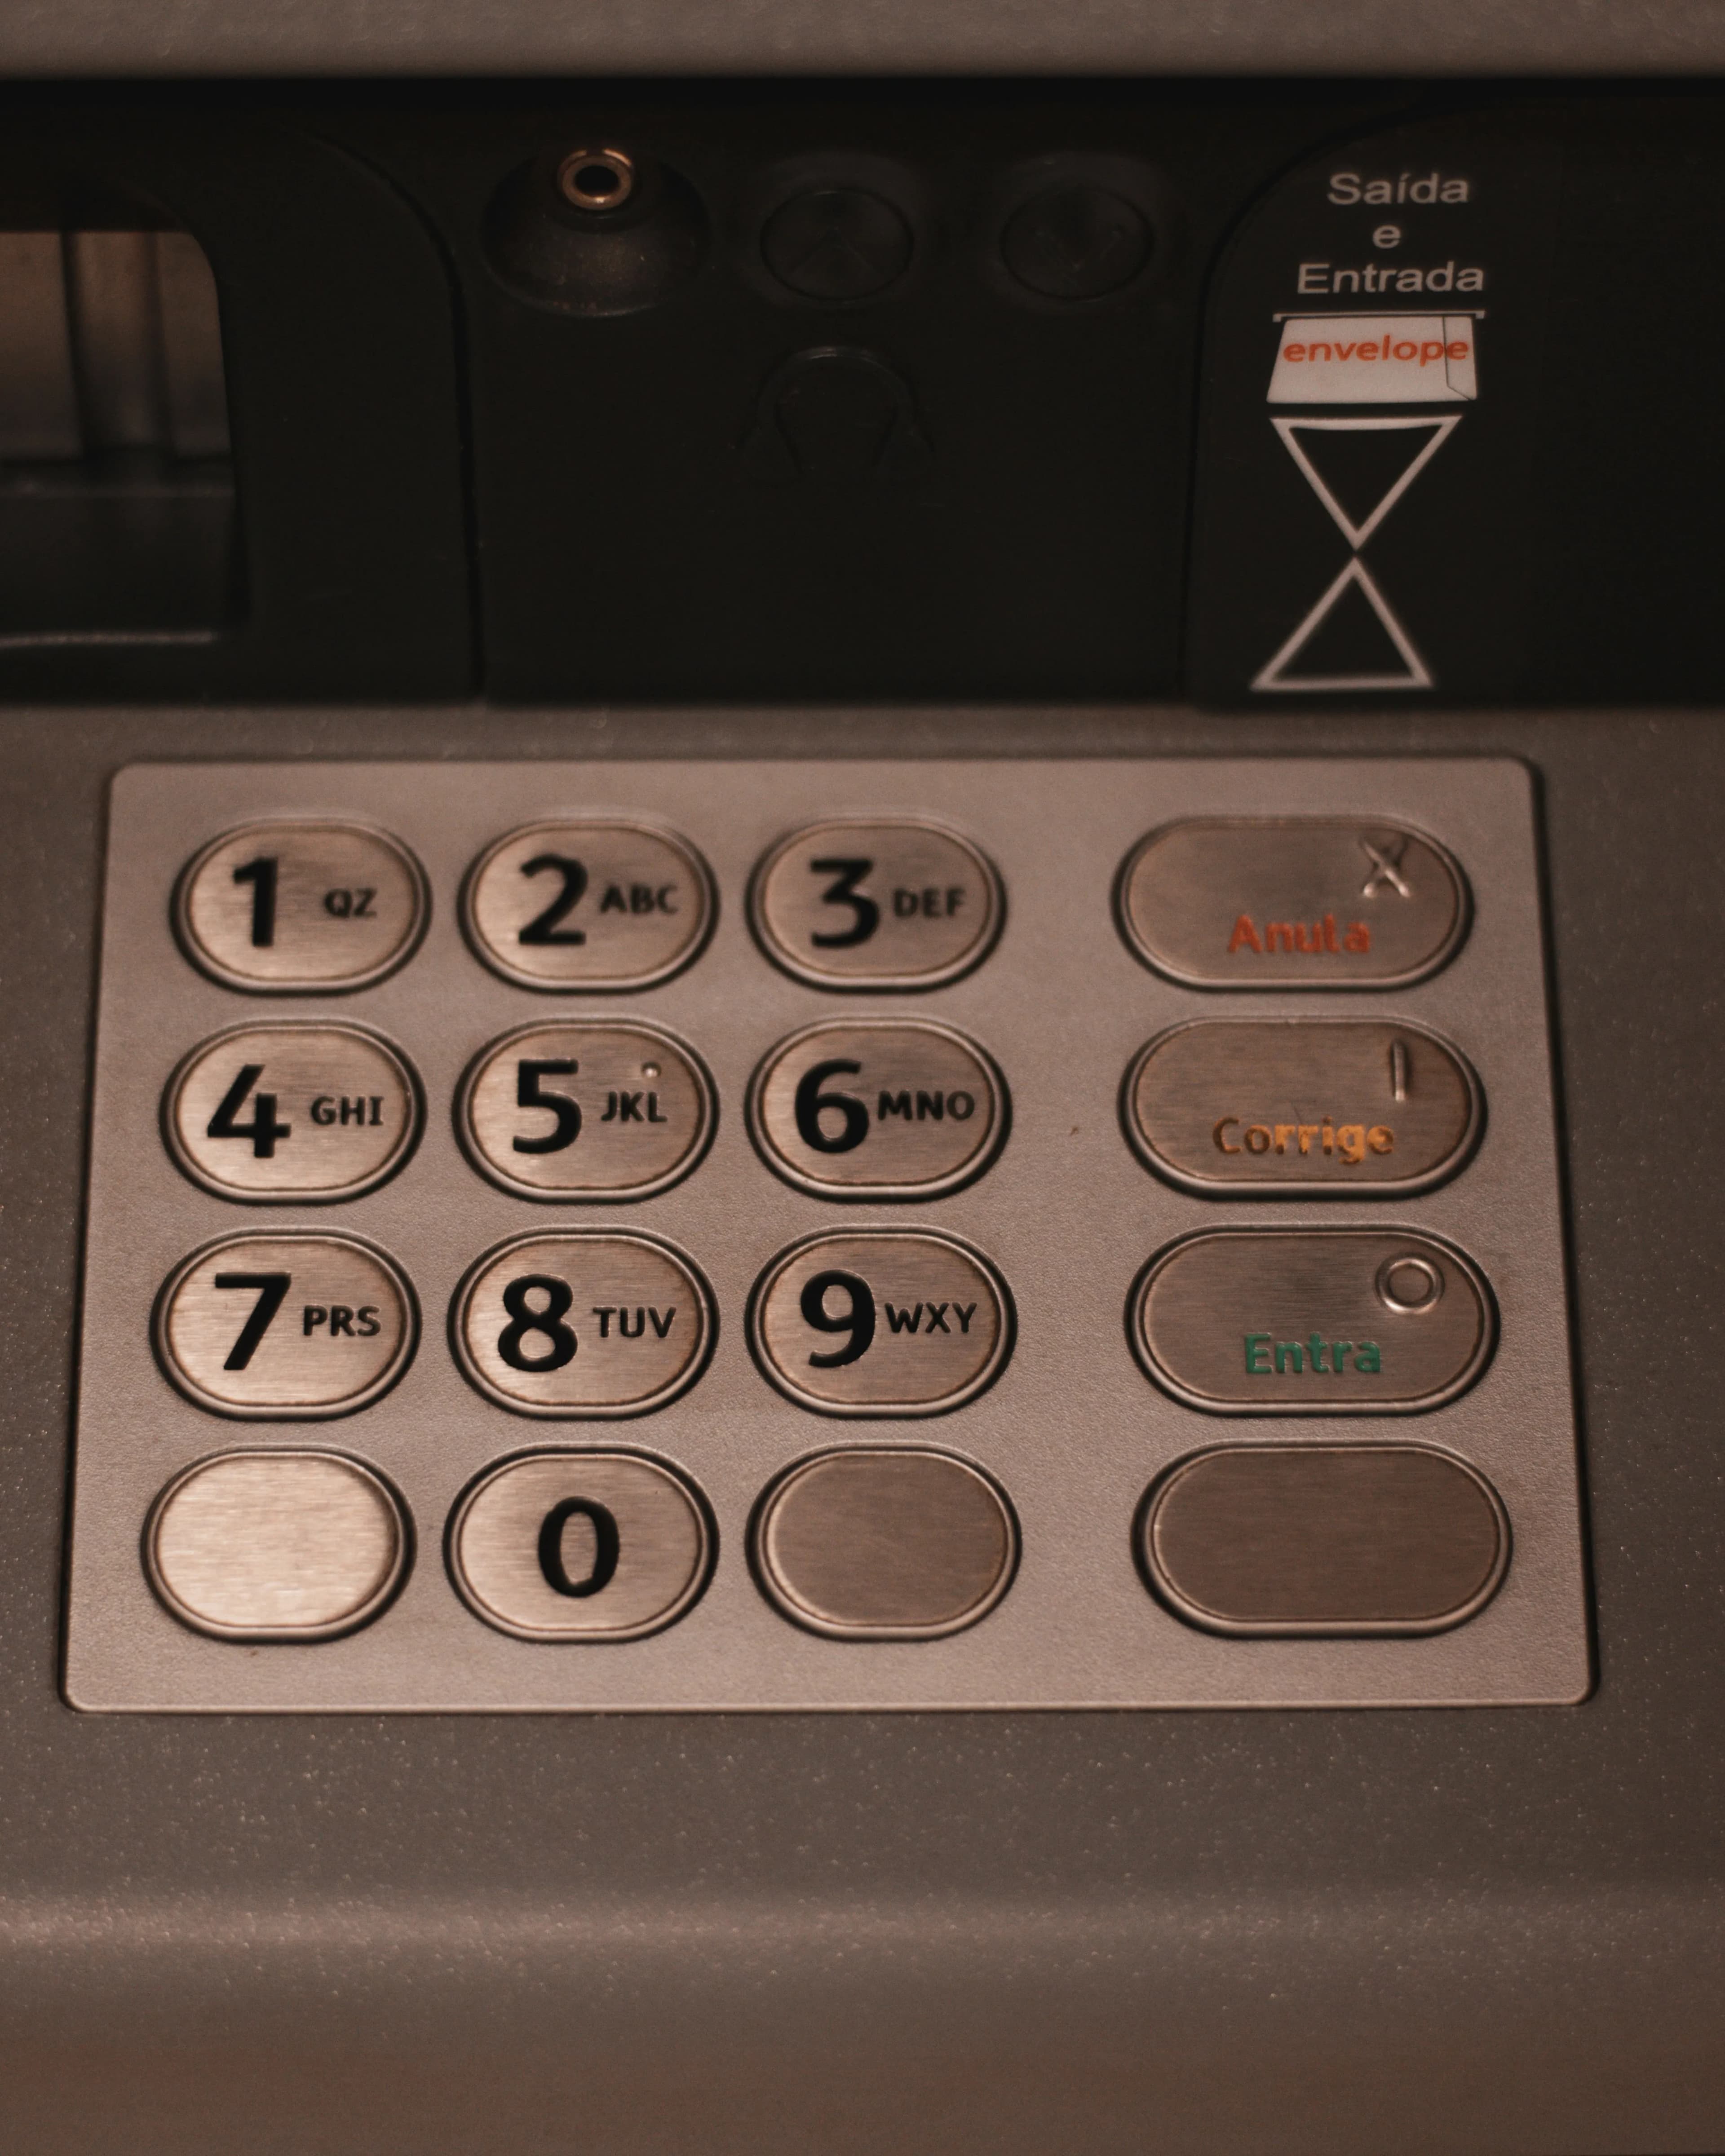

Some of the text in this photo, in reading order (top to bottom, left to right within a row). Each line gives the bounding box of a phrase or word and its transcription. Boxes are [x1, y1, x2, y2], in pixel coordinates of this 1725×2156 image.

[1327, 172, 1470, 204] Saída
[1298, 261, 1483, 294] Entrada
[1372, 225, 1401, 249] e
[1283, 335, 1468, 367] envelope
[232, 856, 377, 948] 1 QZ
[518, 853, 680, 945] 2 ABC
[810, 858, 966, 948] 3 DEF
[1228, 914, 1371, 953] Anula
[207, 1064, 385, 1158] 4 GHI
[513, 1059, 668, 1154] 5 JKL
[795, 1059, 975, 1154] 6 MNO
[1213, 1115, 1395, 1164] Corrige
[214, 1272, 381, 1370] 7 PRS
[497, 1273, 677, 1372] 8 TUV
[800, 1269, 978, 1367] 9 WXY
[1244, 1332, 1382, 1375] Entra
[538, 1495, 620, 1598] 0
